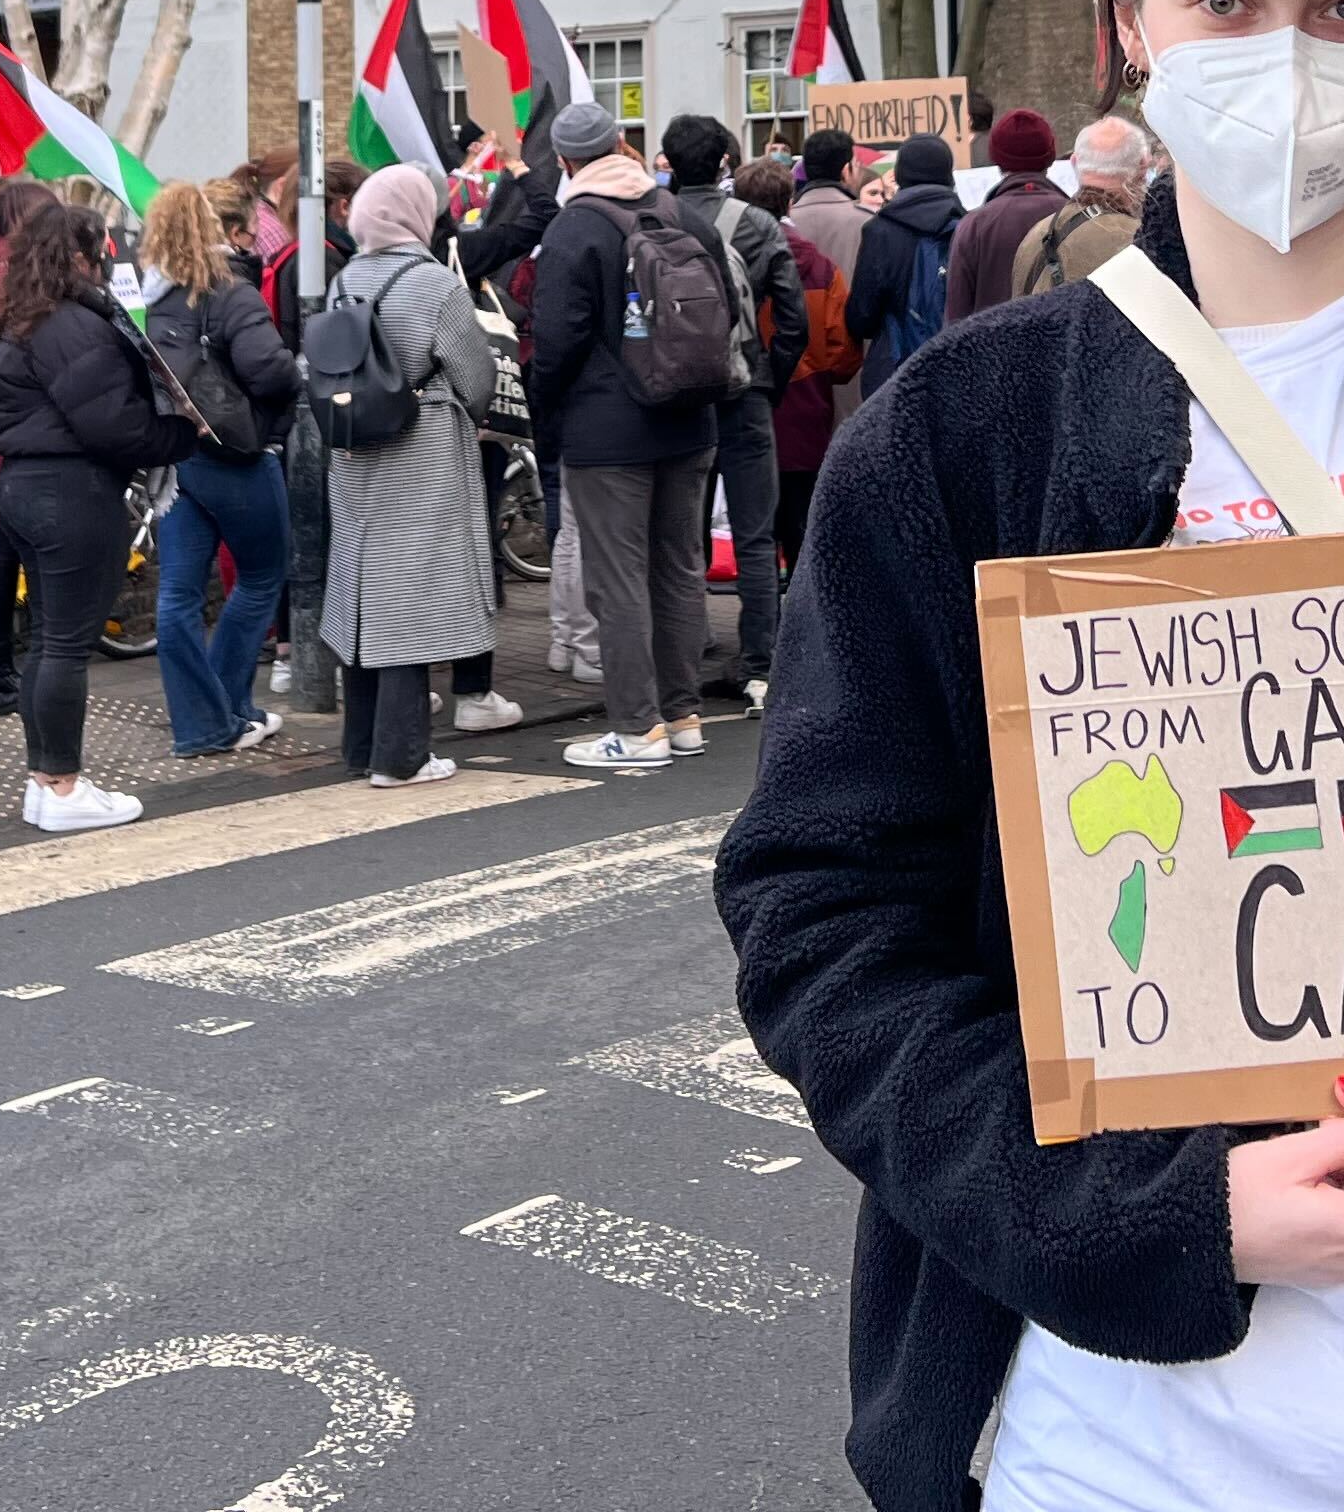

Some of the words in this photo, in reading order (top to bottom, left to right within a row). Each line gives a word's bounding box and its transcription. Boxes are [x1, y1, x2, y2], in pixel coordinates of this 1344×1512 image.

[812, 104, 855, 136] END
[1222, 496, 1277, 523] TO
[1039, 605, 1264, 698] JEWISH
[1052, 705, 1206, 756] FROM
[1077, 981, 1170, 1049] TO
